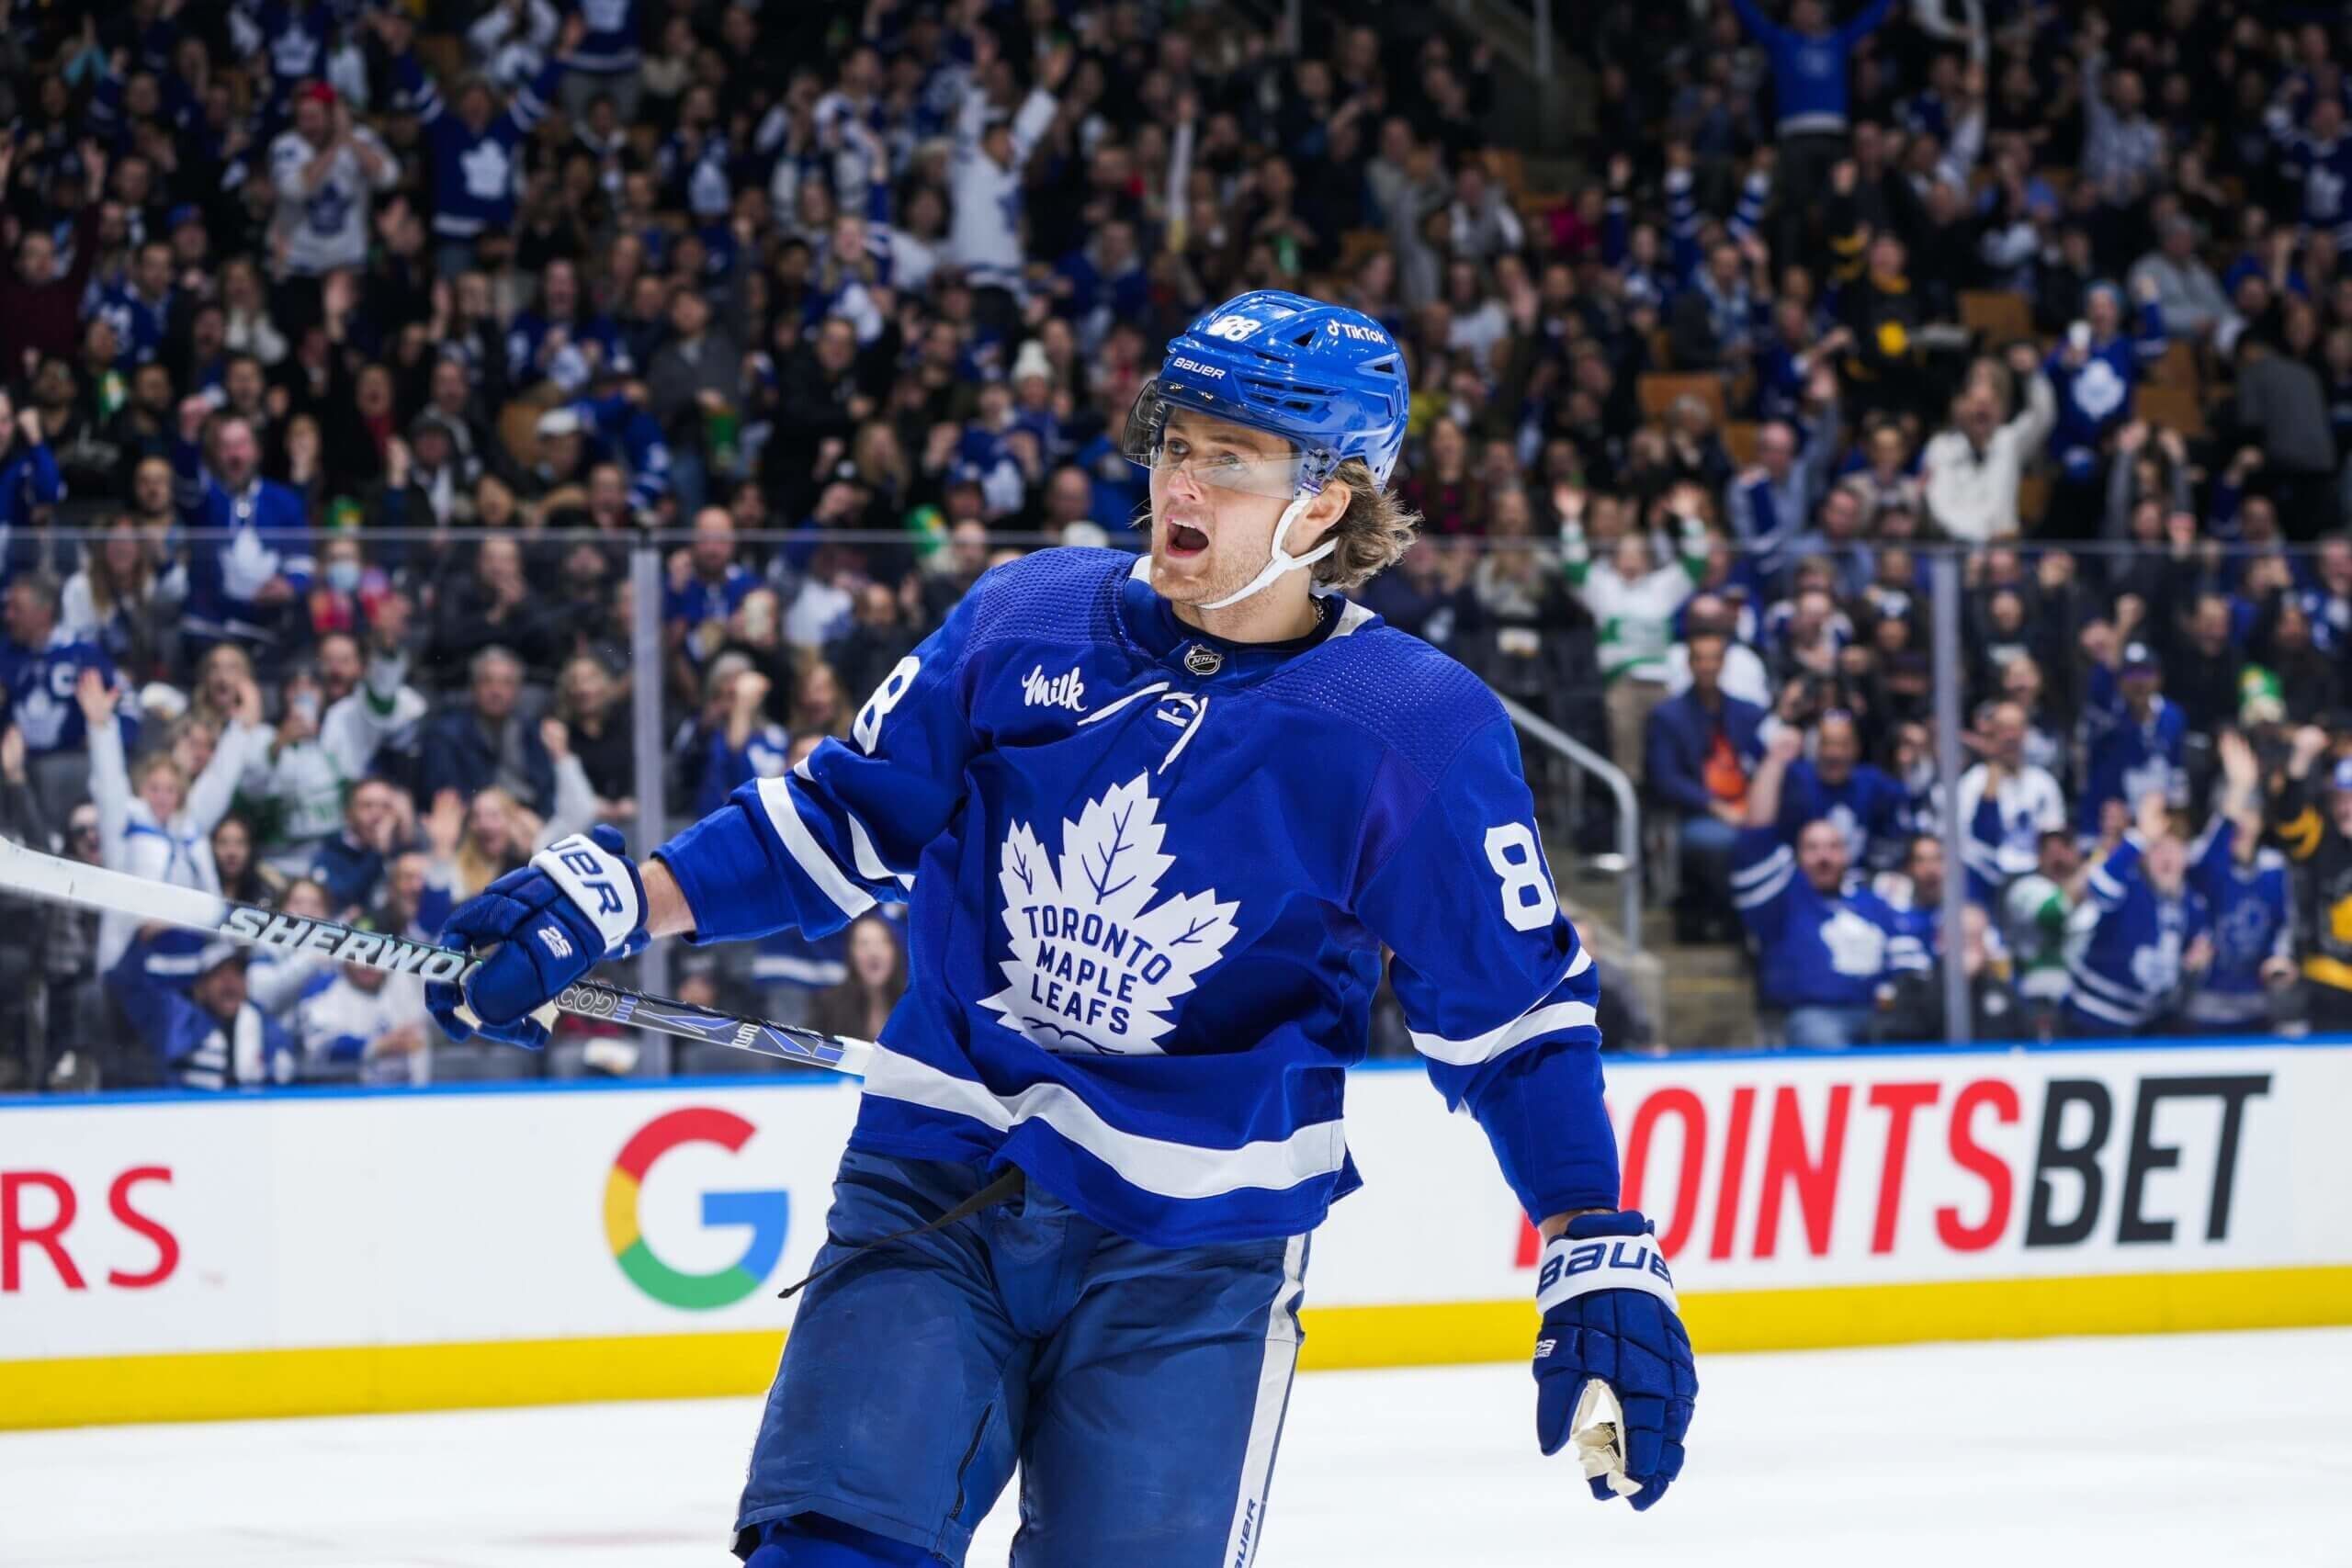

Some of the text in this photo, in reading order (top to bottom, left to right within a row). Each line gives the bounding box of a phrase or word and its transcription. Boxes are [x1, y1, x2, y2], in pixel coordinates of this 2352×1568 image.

[1340, 323, 1387, 345] TikTok
[1173, 357, 1226, 379] BAUER
[1022, 664, 1088, 712] Milk
[1484, 818, 1559, 931] 8
[220, 907, 483, 983] SHERWO
[1022, 905, 1171, 985] TORONTO
[1036, 940, 1137, 1003] MAPLE
[1031, 974, 1129, 1035] LEAFS
[1514, 1073, 2272, 1268] OINTSBET
[604, 1107, 790, 1308] G
[1536, 1242, 1674, 1298] BAUE
